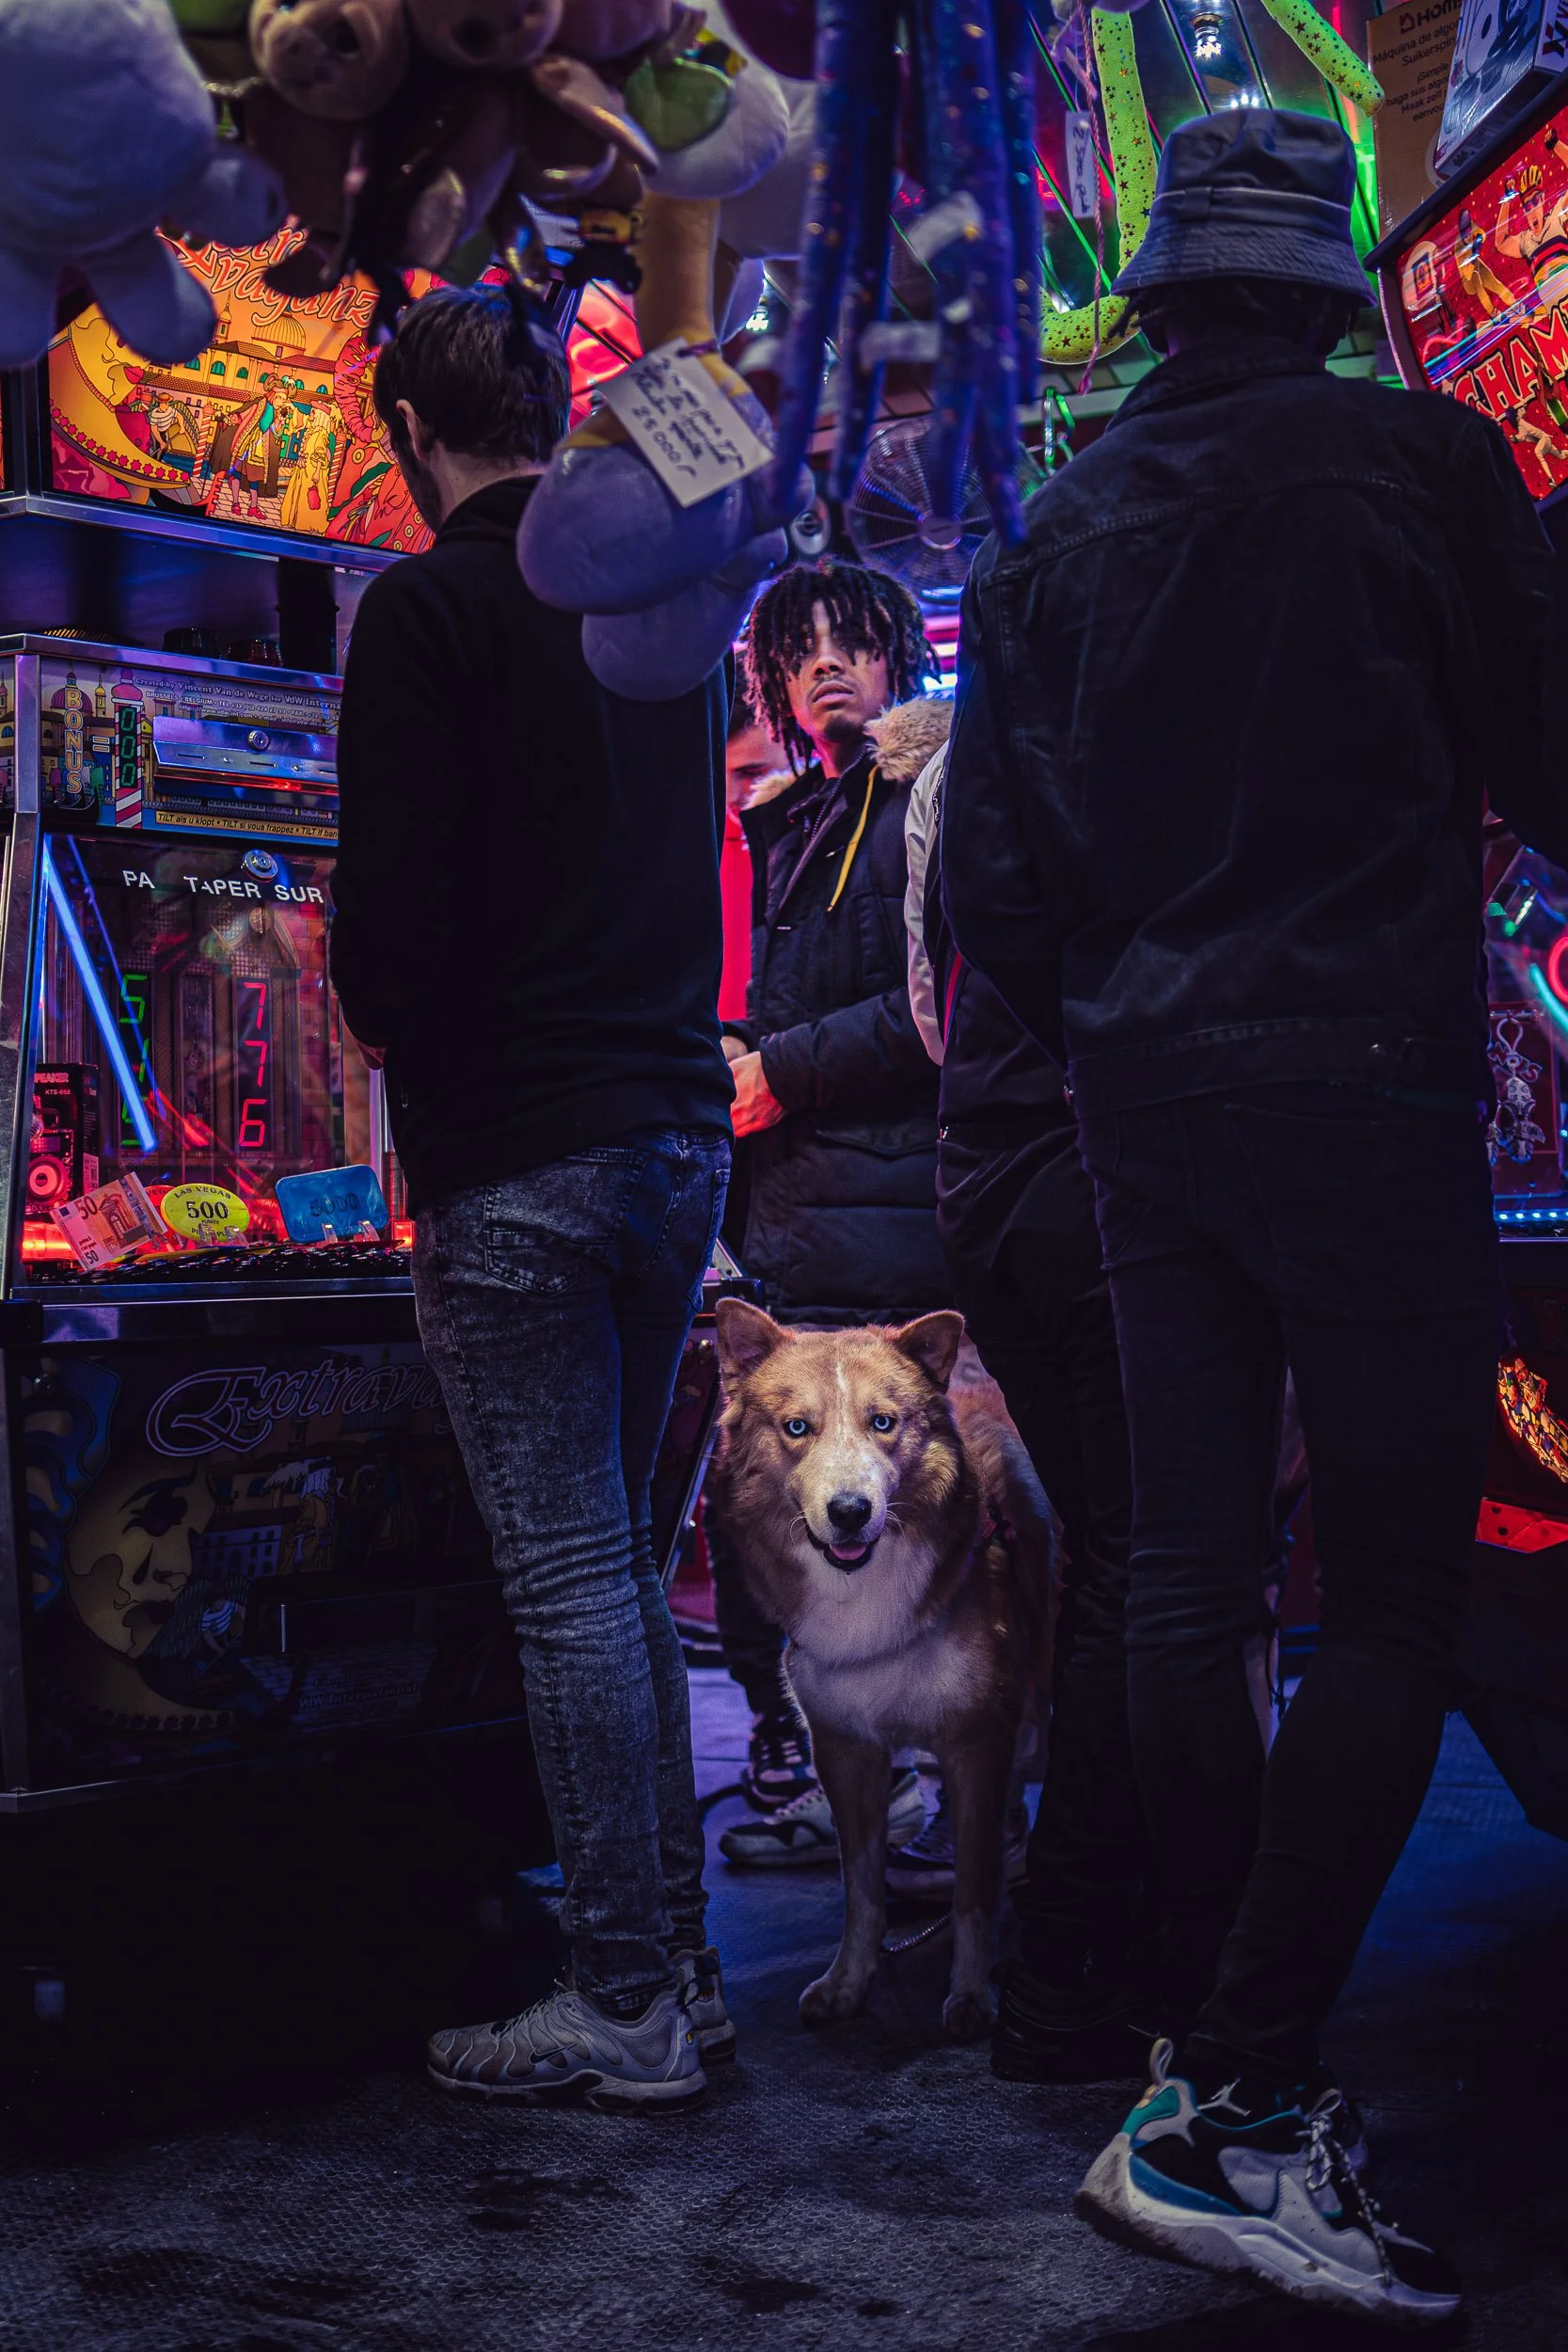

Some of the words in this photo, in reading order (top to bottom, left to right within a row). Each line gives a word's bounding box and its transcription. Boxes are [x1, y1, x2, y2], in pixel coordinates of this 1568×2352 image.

[1419, 33, 1432, 44] de
[1410, 87, 1426, 98] sus
[1454, 297, 1568, 423] CHAM
[146, 691, 179, 700] BRUSSELS
[178, 682, 213, 693] Vincent
[214, 687, 231, 696] Van
[246, 691, 270, 701] Wege
[284, 695, 303, 705] VdW
[65, 688, 83, 794] BONUS
[158, 813, 175, 822] TILT
[196, 818, 214, 826] klopt
[222, 819, 239, 828] TILT
[266, 823, 293, 834] frappez
[324, 829, 339, 838] ban
[122, 869, 156, 889] PA
[183, 876, 262, 898] TAPER
[275, 884, 325, 903] SUR
[174, 1187, 193, 1199] LAS
[196, 1186, 231, 1200] VEGAS
[309, 1193, 359, 1216] 5000
[74, 1196, 98, 1220] 50
[186, 1201, 229, 1219] 500
[85, 1250, 99, 1264] 50
[145, 1359, 458, 1457] Extrava
